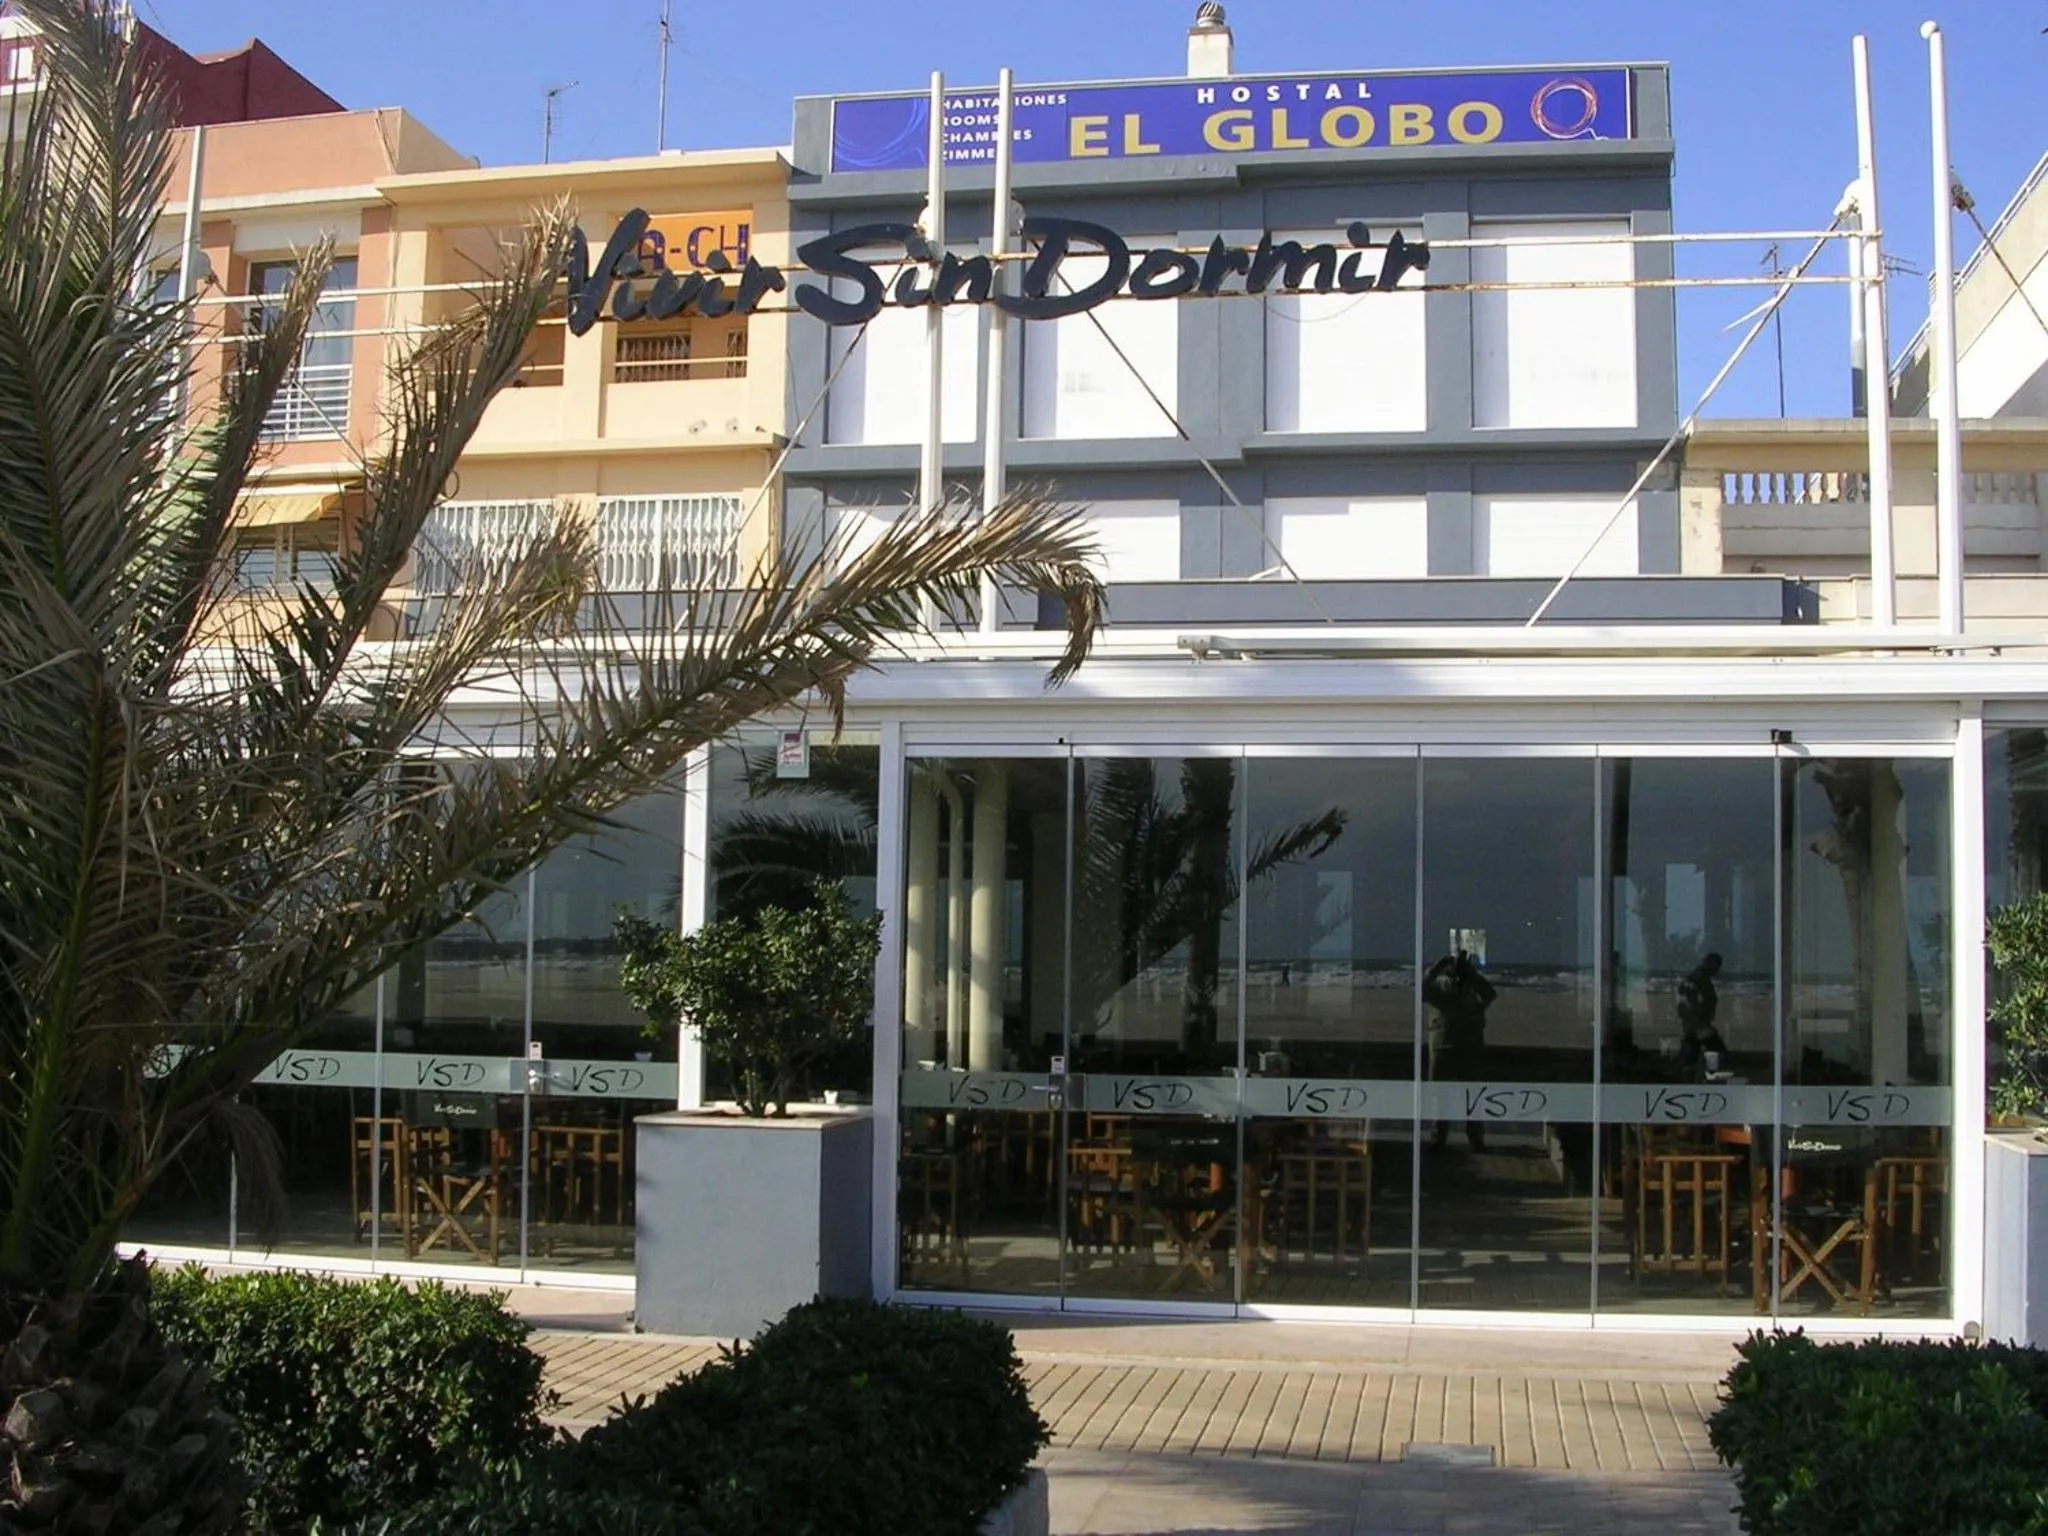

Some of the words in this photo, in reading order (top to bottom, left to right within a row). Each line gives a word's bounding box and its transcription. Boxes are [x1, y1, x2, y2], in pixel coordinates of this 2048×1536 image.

[943, 94, 1067, 110] HABITAIONES
[1197, 83, 1372, 105] HOSTAL
[942, 129, 1033, 144] HAMBES
[1070, 113, 1161, 157] EL
[1203, 101, 1504, 151] GLOBO
[567, 207, 786, 338] Vivir
[795, 223, 993, 326] Sin
[994, 217, 1430, 320] Dormir
[274, 1053, 340, 1081] VSD
[417, 1058, 486, 1087] VSD
[571, 1064, 645, 1094] VSD
[950, 1075, 1026, 1105] VSD
[1114, 1079, 1193, 1110] VSD
[1286, 1082, 1368, 1114] VSD
[1464, 1086, 1548, 1118] VSD
[1644, 1088, 1727, 1120] VSD
[1826, 1090, 1911, 1122] VSD
